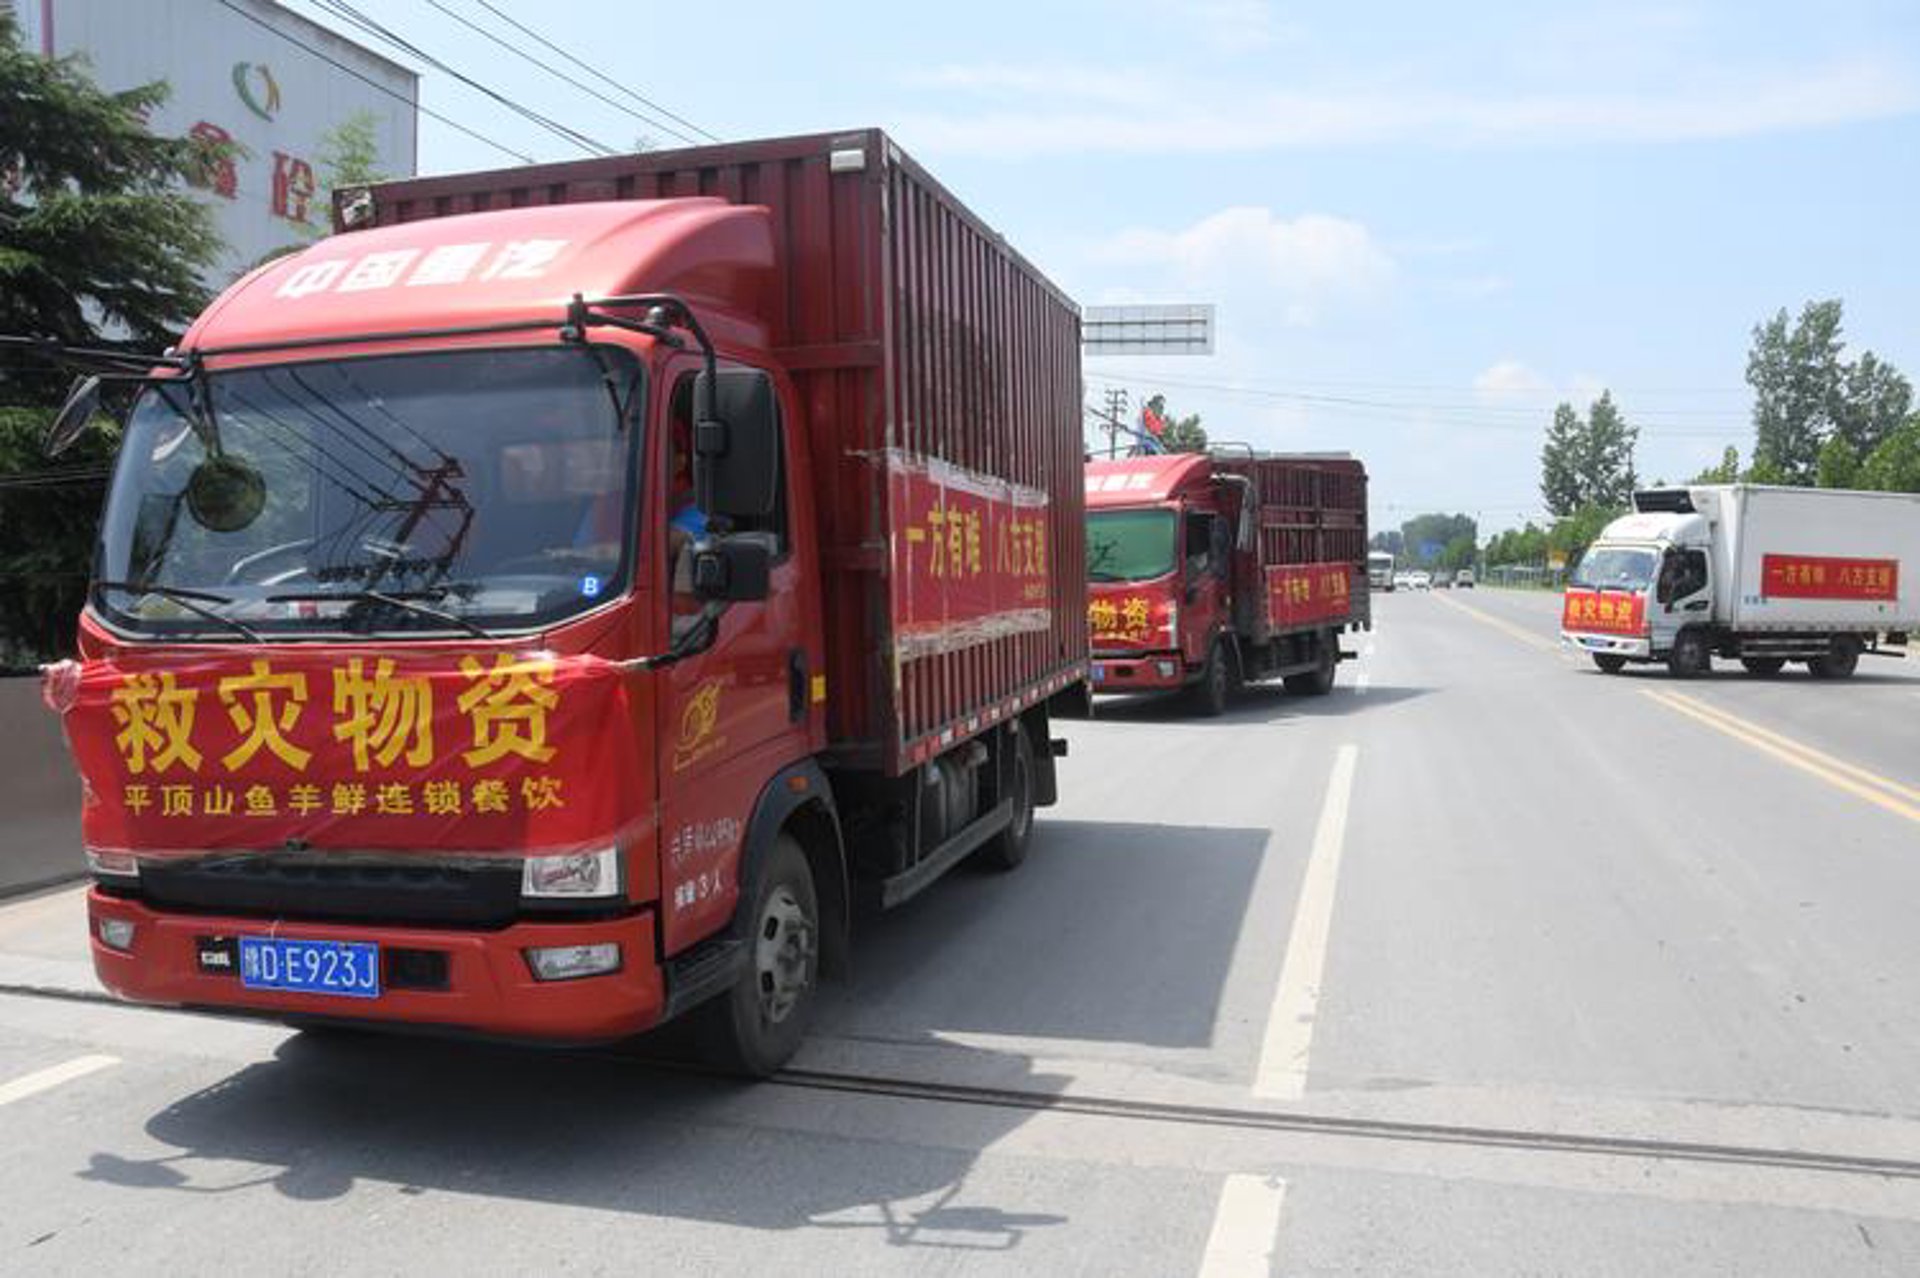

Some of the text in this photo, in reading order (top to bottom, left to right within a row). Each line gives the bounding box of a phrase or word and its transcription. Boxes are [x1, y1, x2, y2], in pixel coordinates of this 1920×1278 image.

[275, 239, 571, 298] 中国重汽
[582, 576, 599, 595] B
[111, 651, 562, 774] 救灾物资
[122, 777, 567, 818] 平顶山鱼羊鲜连锁餐饮
